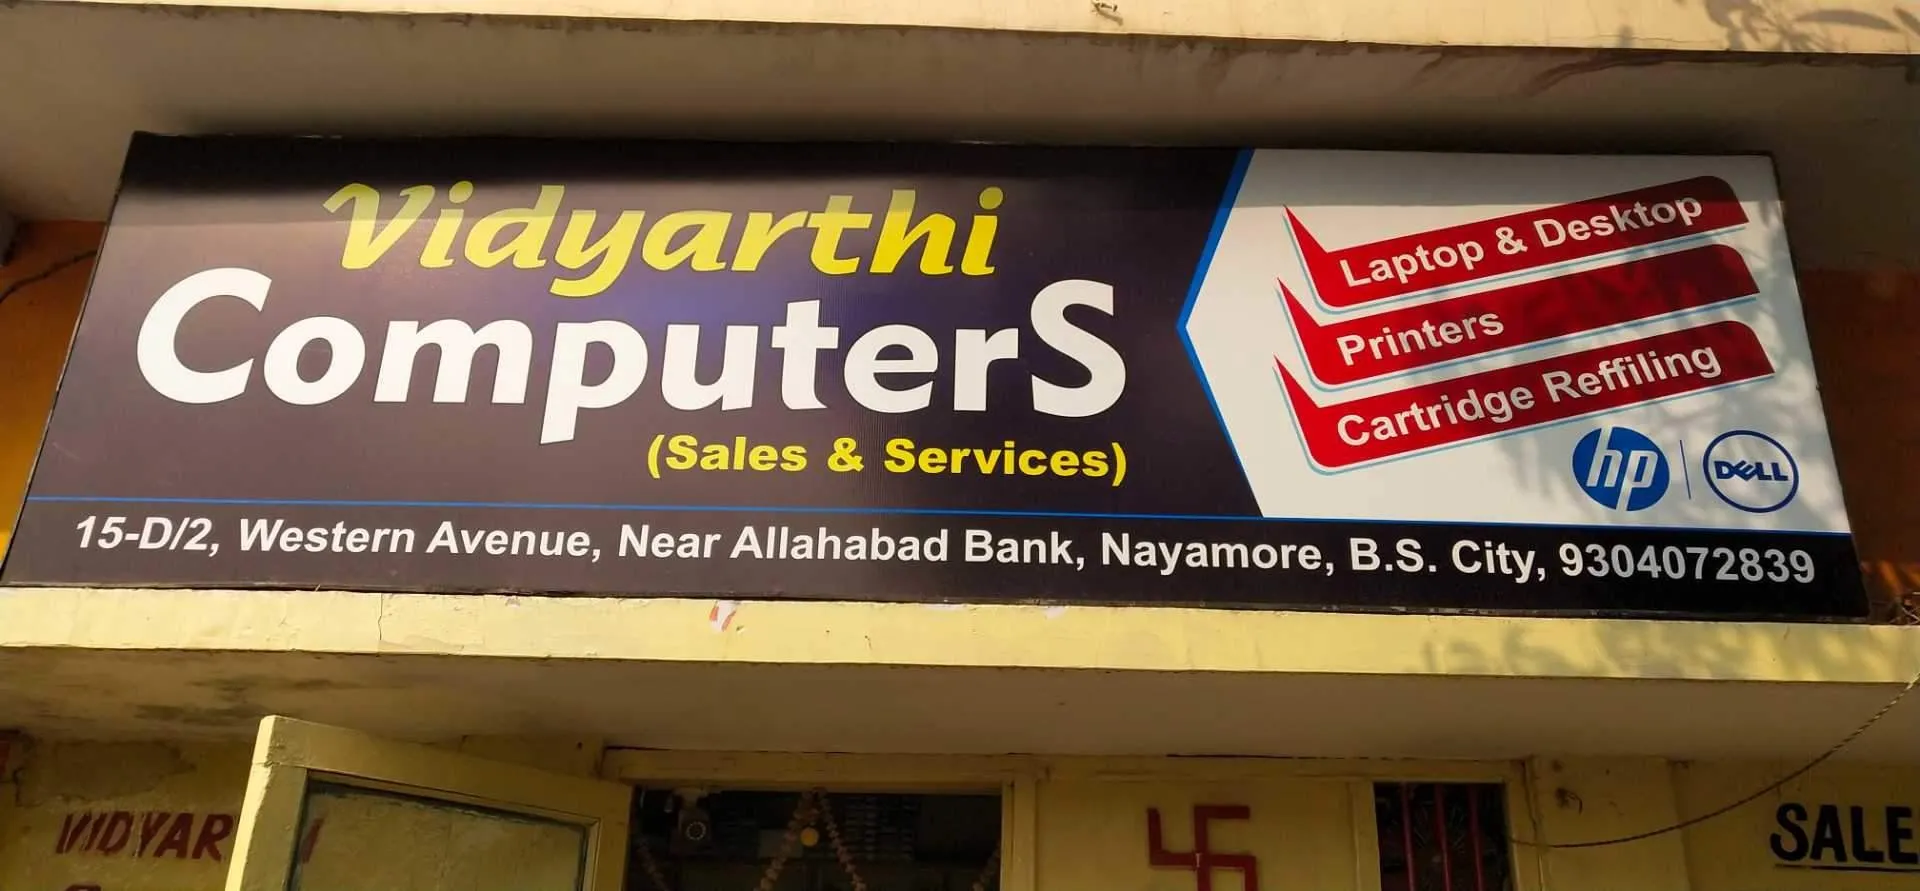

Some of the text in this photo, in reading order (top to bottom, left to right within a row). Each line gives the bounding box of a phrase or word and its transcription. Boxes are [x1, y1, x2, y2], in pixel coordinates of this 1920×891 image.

[325, 181, 1004, 297] Vidyarthi
[1339, 195, 1703, 287] Laptop & Desktop
[136, 267, 1126, 444] ComputerS
[1336, 312, 1504, 366] Printers
[1337, 346, 1722, 446] Cartridge Reffiling
[647, 433, 1127, 487] (Sales & Services)
[1586, 426, 1659, 511] hp
[1714, 460, 1789, 482] DELL
[76, 516, 1815, 584] 15-D/2, Western Avenue, Near Allahabad Bank, Nayamore, B.S. City, 9304072839
